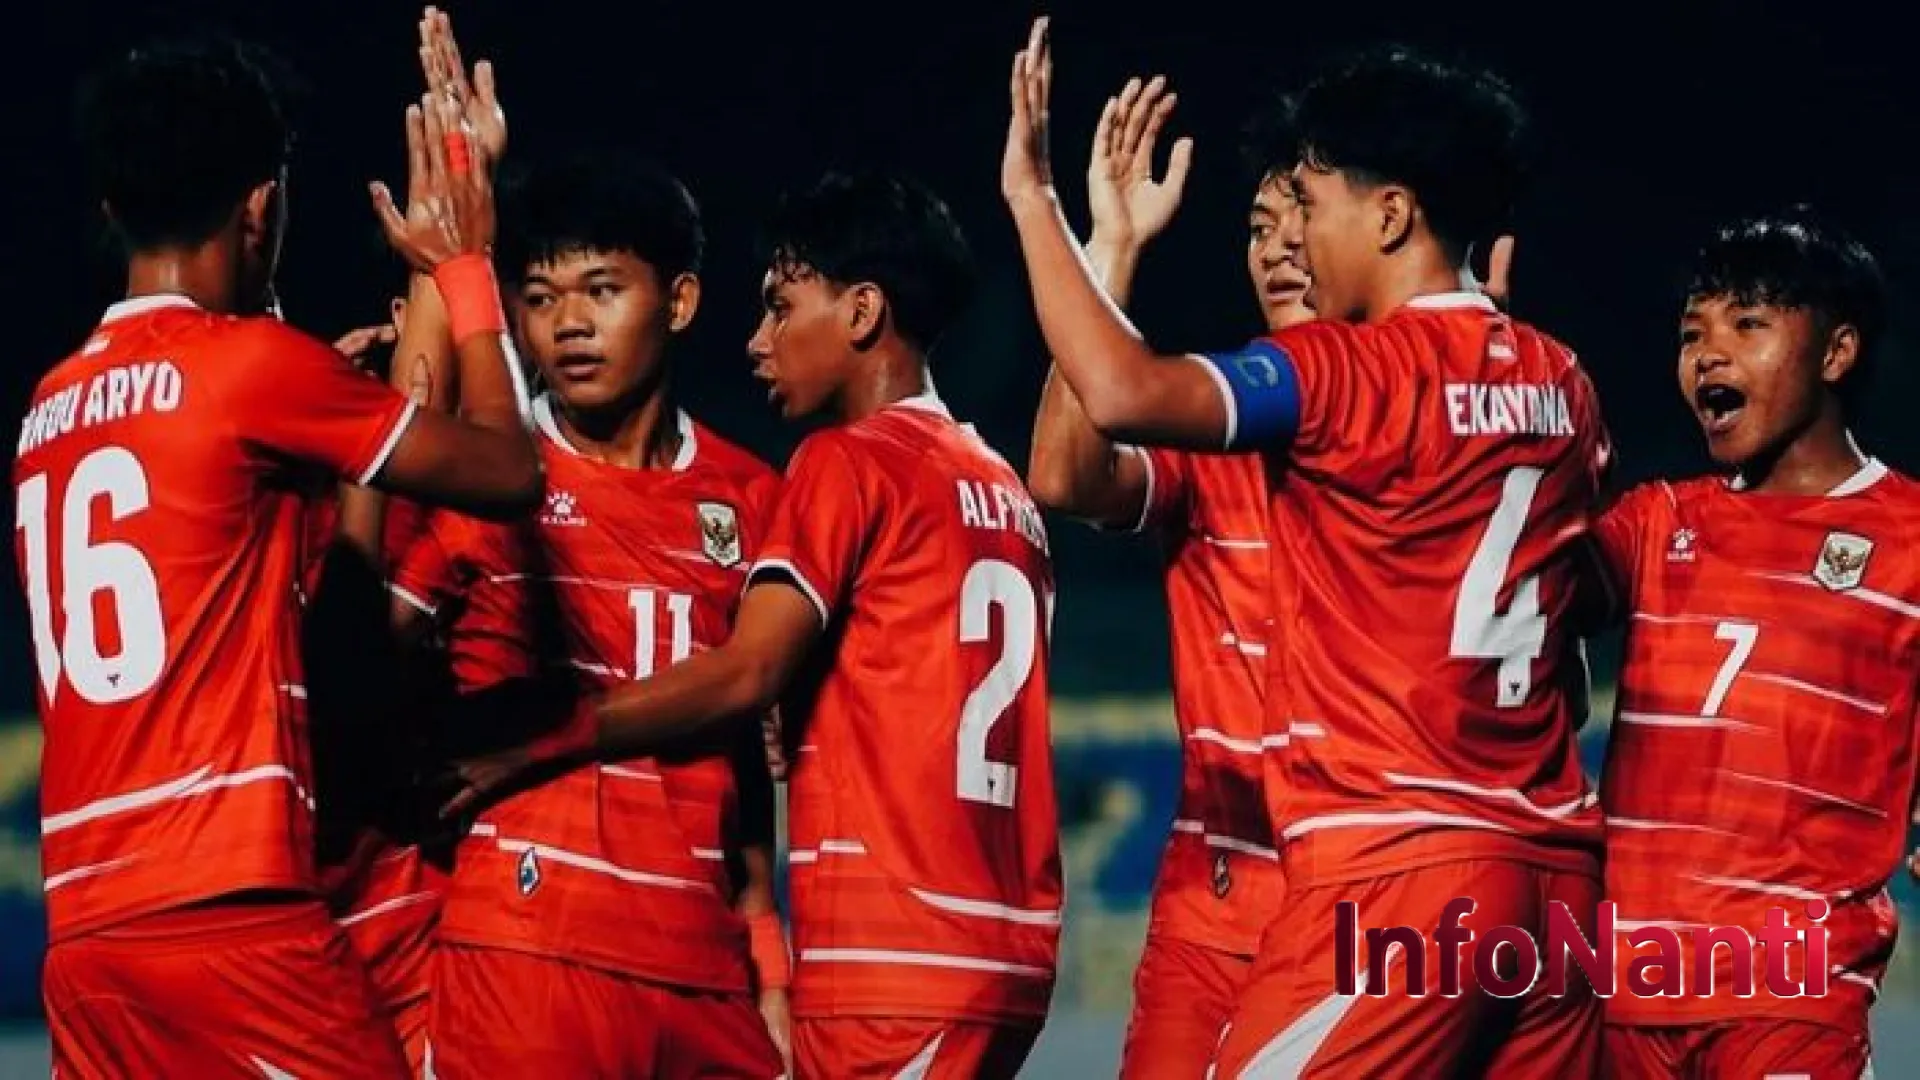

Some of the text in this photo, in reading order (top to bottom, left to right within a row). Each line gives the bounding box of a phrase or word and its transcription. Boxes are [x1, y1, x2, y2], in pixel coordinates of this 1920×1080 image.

[82, 360, 183, 429] ARYO
[1444, 383, 1576, 437] EKAYANA
[15, 445, 167, 710] 16
[1449, 466, 1548, 708] 4
[627, 587, 693, 681] 11
[1701, 620, 1759, 718] 7
[956, 558, 1056, 810] 2
